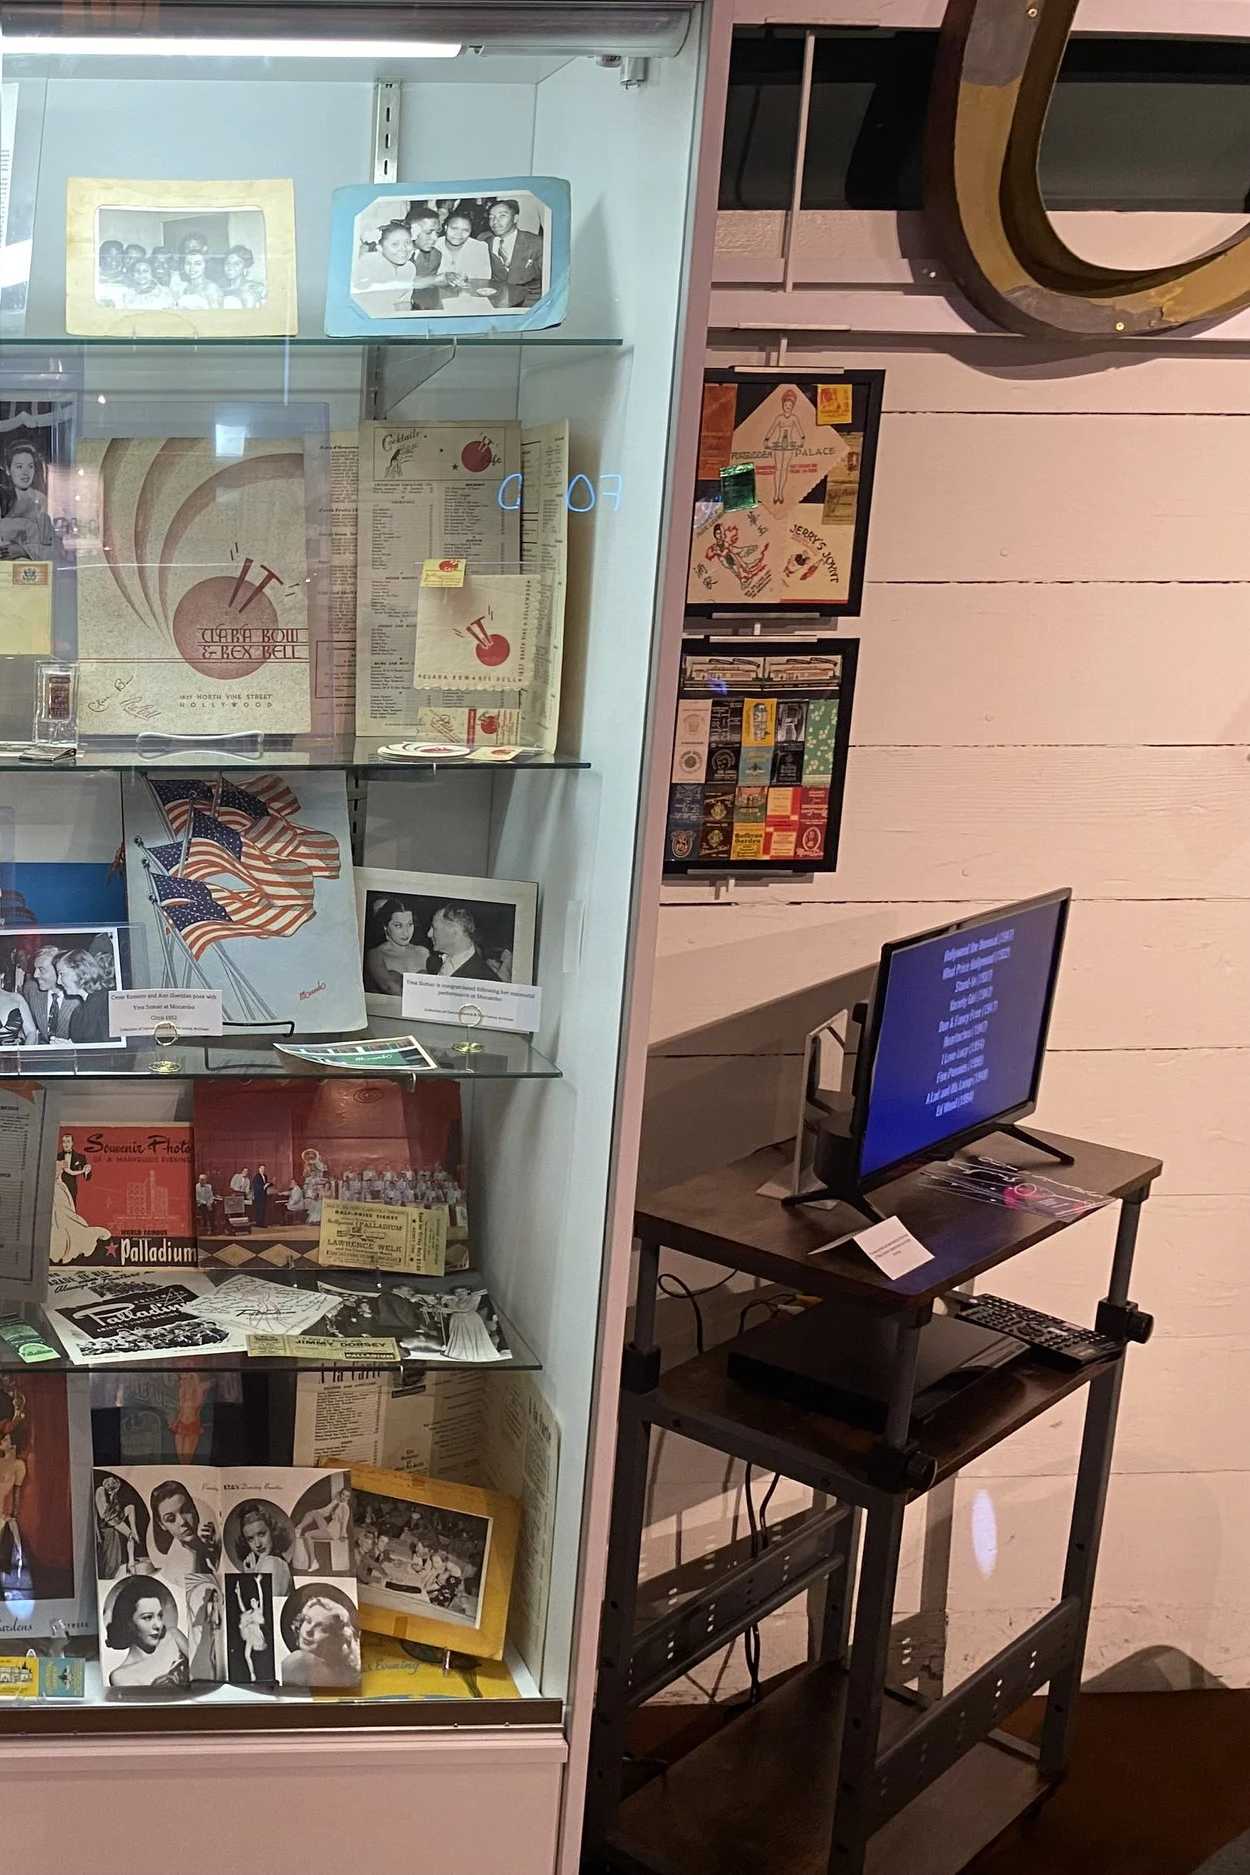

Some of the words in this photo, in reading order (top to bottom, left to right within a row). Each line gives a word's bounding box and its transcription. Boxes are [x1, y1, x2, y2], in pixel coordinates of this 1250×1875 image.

[794, 447, 835, 458] PALACE
[789, 524, 827, 551] JERRY'S
[822, 552, 839, 583] JOYNT
[201, 624, 252, 643] CLARA
[262, 628, 299, 643] BOW
[202, 645, 217, 659] &
[221, 645, 252, 660] REX
[262, 645, 301, 660] BELL
[84, 1133, 146, 1154] Souvenir
[145, 1134, 191, 1154] Photo
[359, 1221, 403, 1231] PALLADIUM
[121, 1238, 197, 1266] Palladium
[327, 1239, 375, 1250] LAWRENCE
[378, 1244, 402, 1253] WELK
[49, 1277, 76, 1287] ARADE
[295, 1339, 335, 1347] JIMMY
